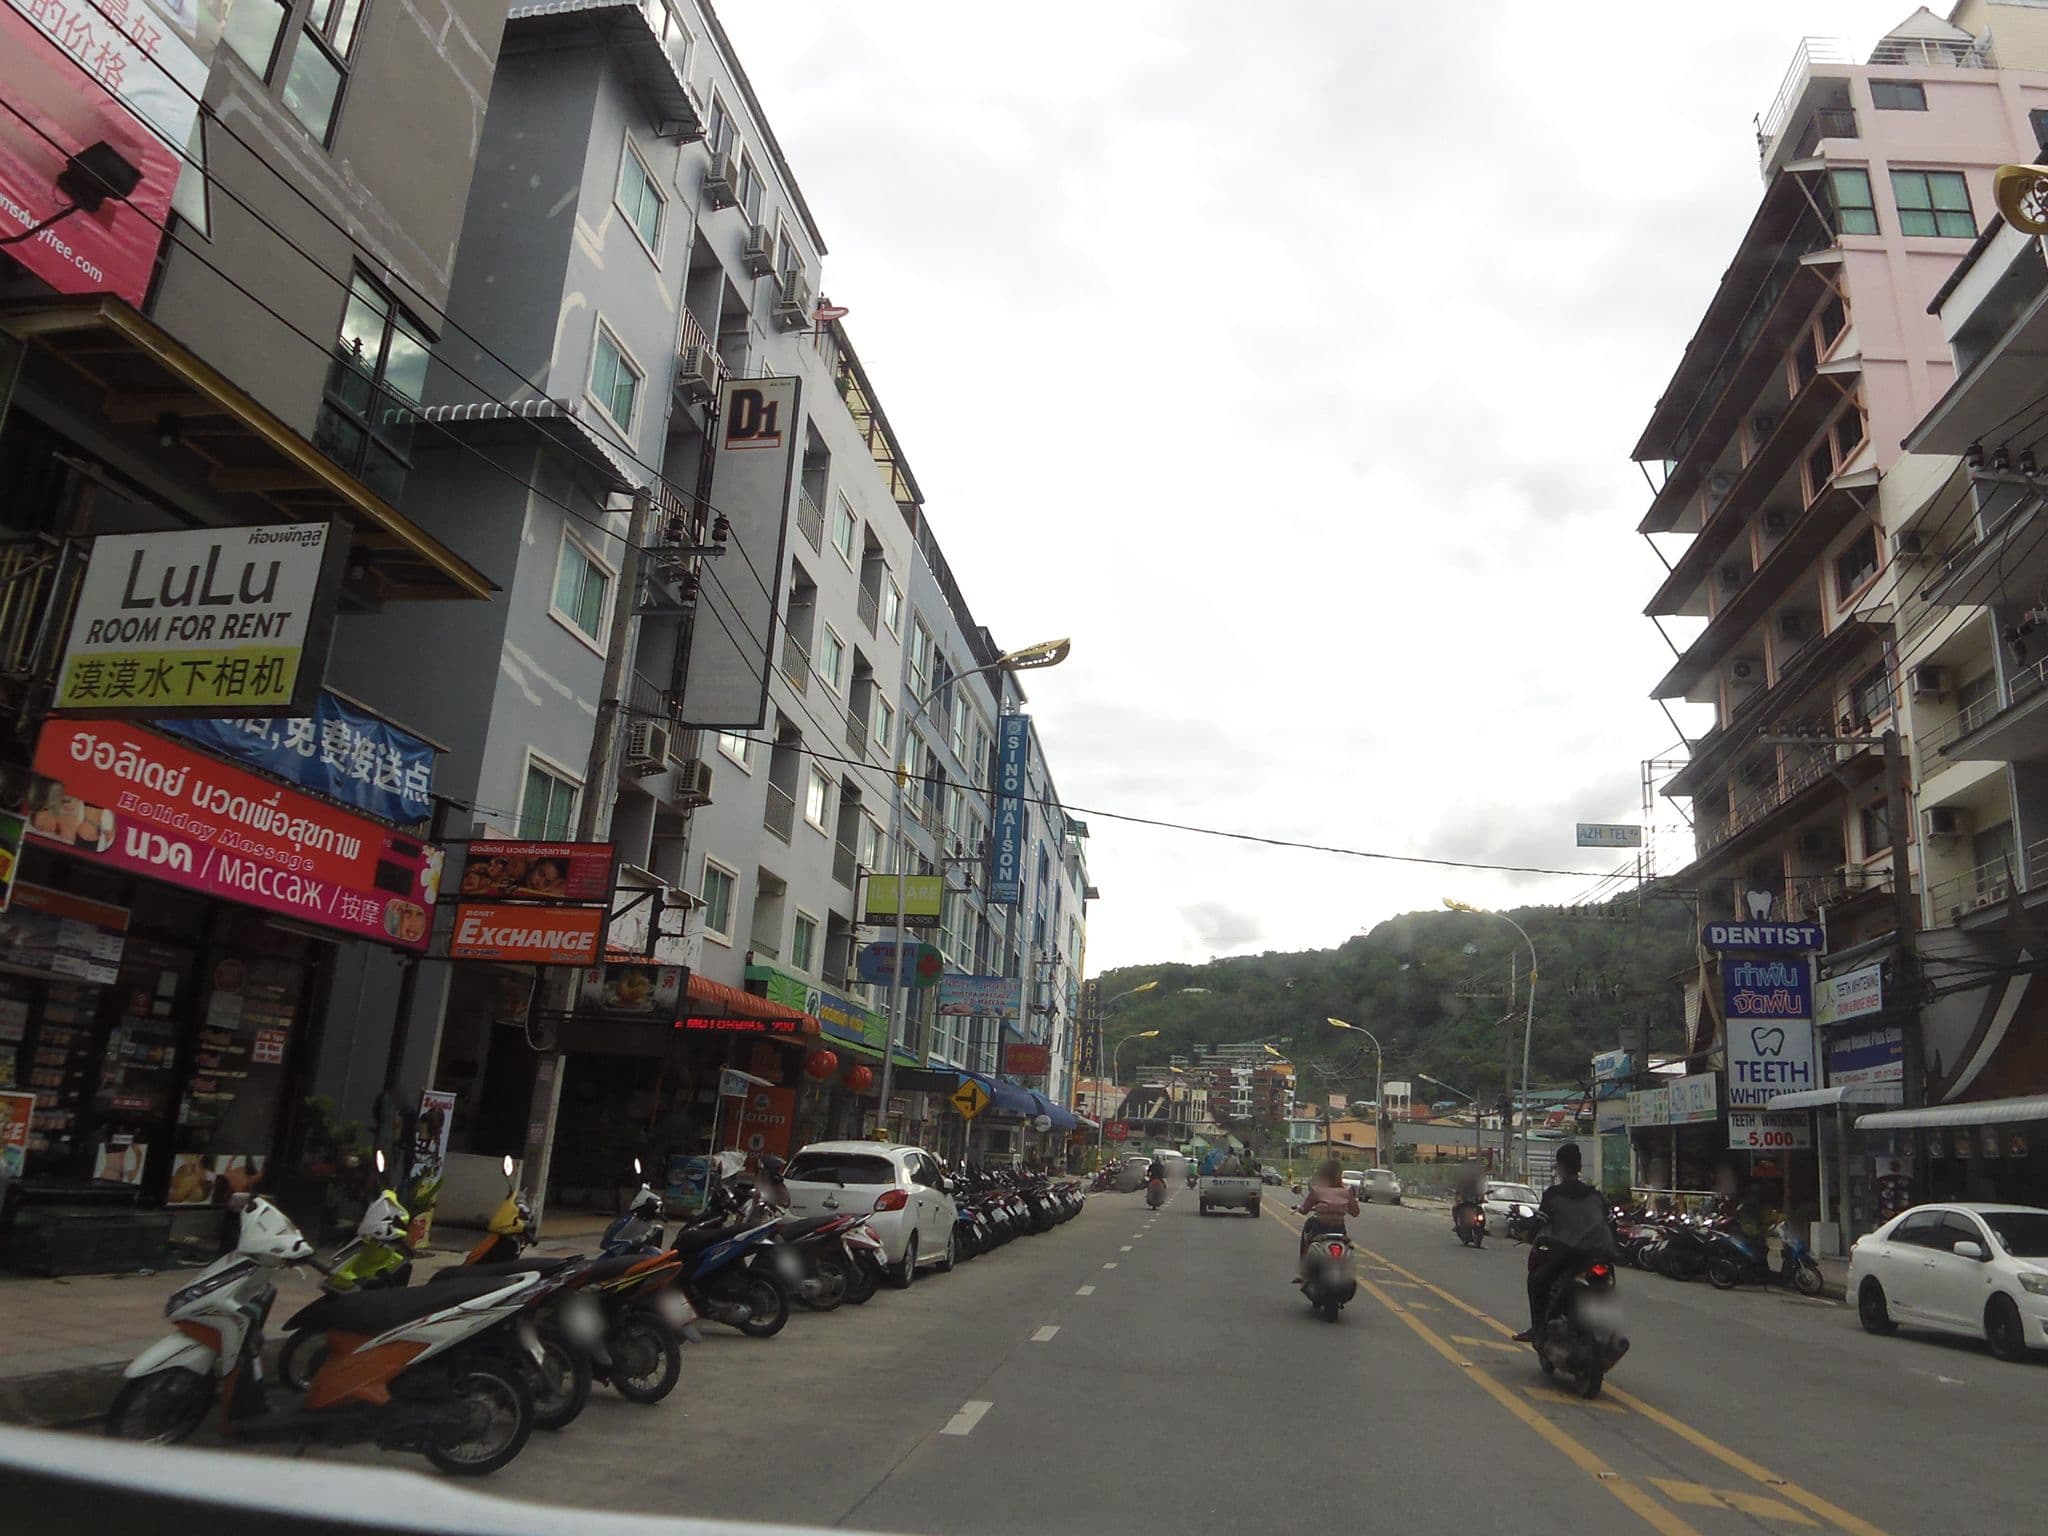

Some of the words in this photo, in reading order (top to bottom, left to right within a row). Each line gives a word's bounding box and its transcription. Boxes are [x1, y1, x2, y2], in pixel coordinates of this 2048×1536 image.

[727, 388, 782, 438] D1
[121, 545, 281, 609] LuLu
[85, 616, 162, 644] ROOM
[165, 614, 216, 641] FOR
[220, 612, 292, 640] RENT
[1004, 736, 1019, 791] SINO
[117, 791, 216, 841] Holiday
[218, 828, 315, 872] Massage
[1000, 797, 1017, 881] MAISON
[125, 827, 193, 873] นวด
[341, 893, 380, 926] 按摩
[1711, 927, 1815, 945] DENTIST
[1734, 962, 1799, 987] ทำฟัน
[1733, 989, 1802, 1014] จัดฟัน
[1735, 1061, 1809, 1083] TEETH
[1731, 1113, 1755, 1127] TEETH
[1749, 1132, 1794, 1147] 5,000
